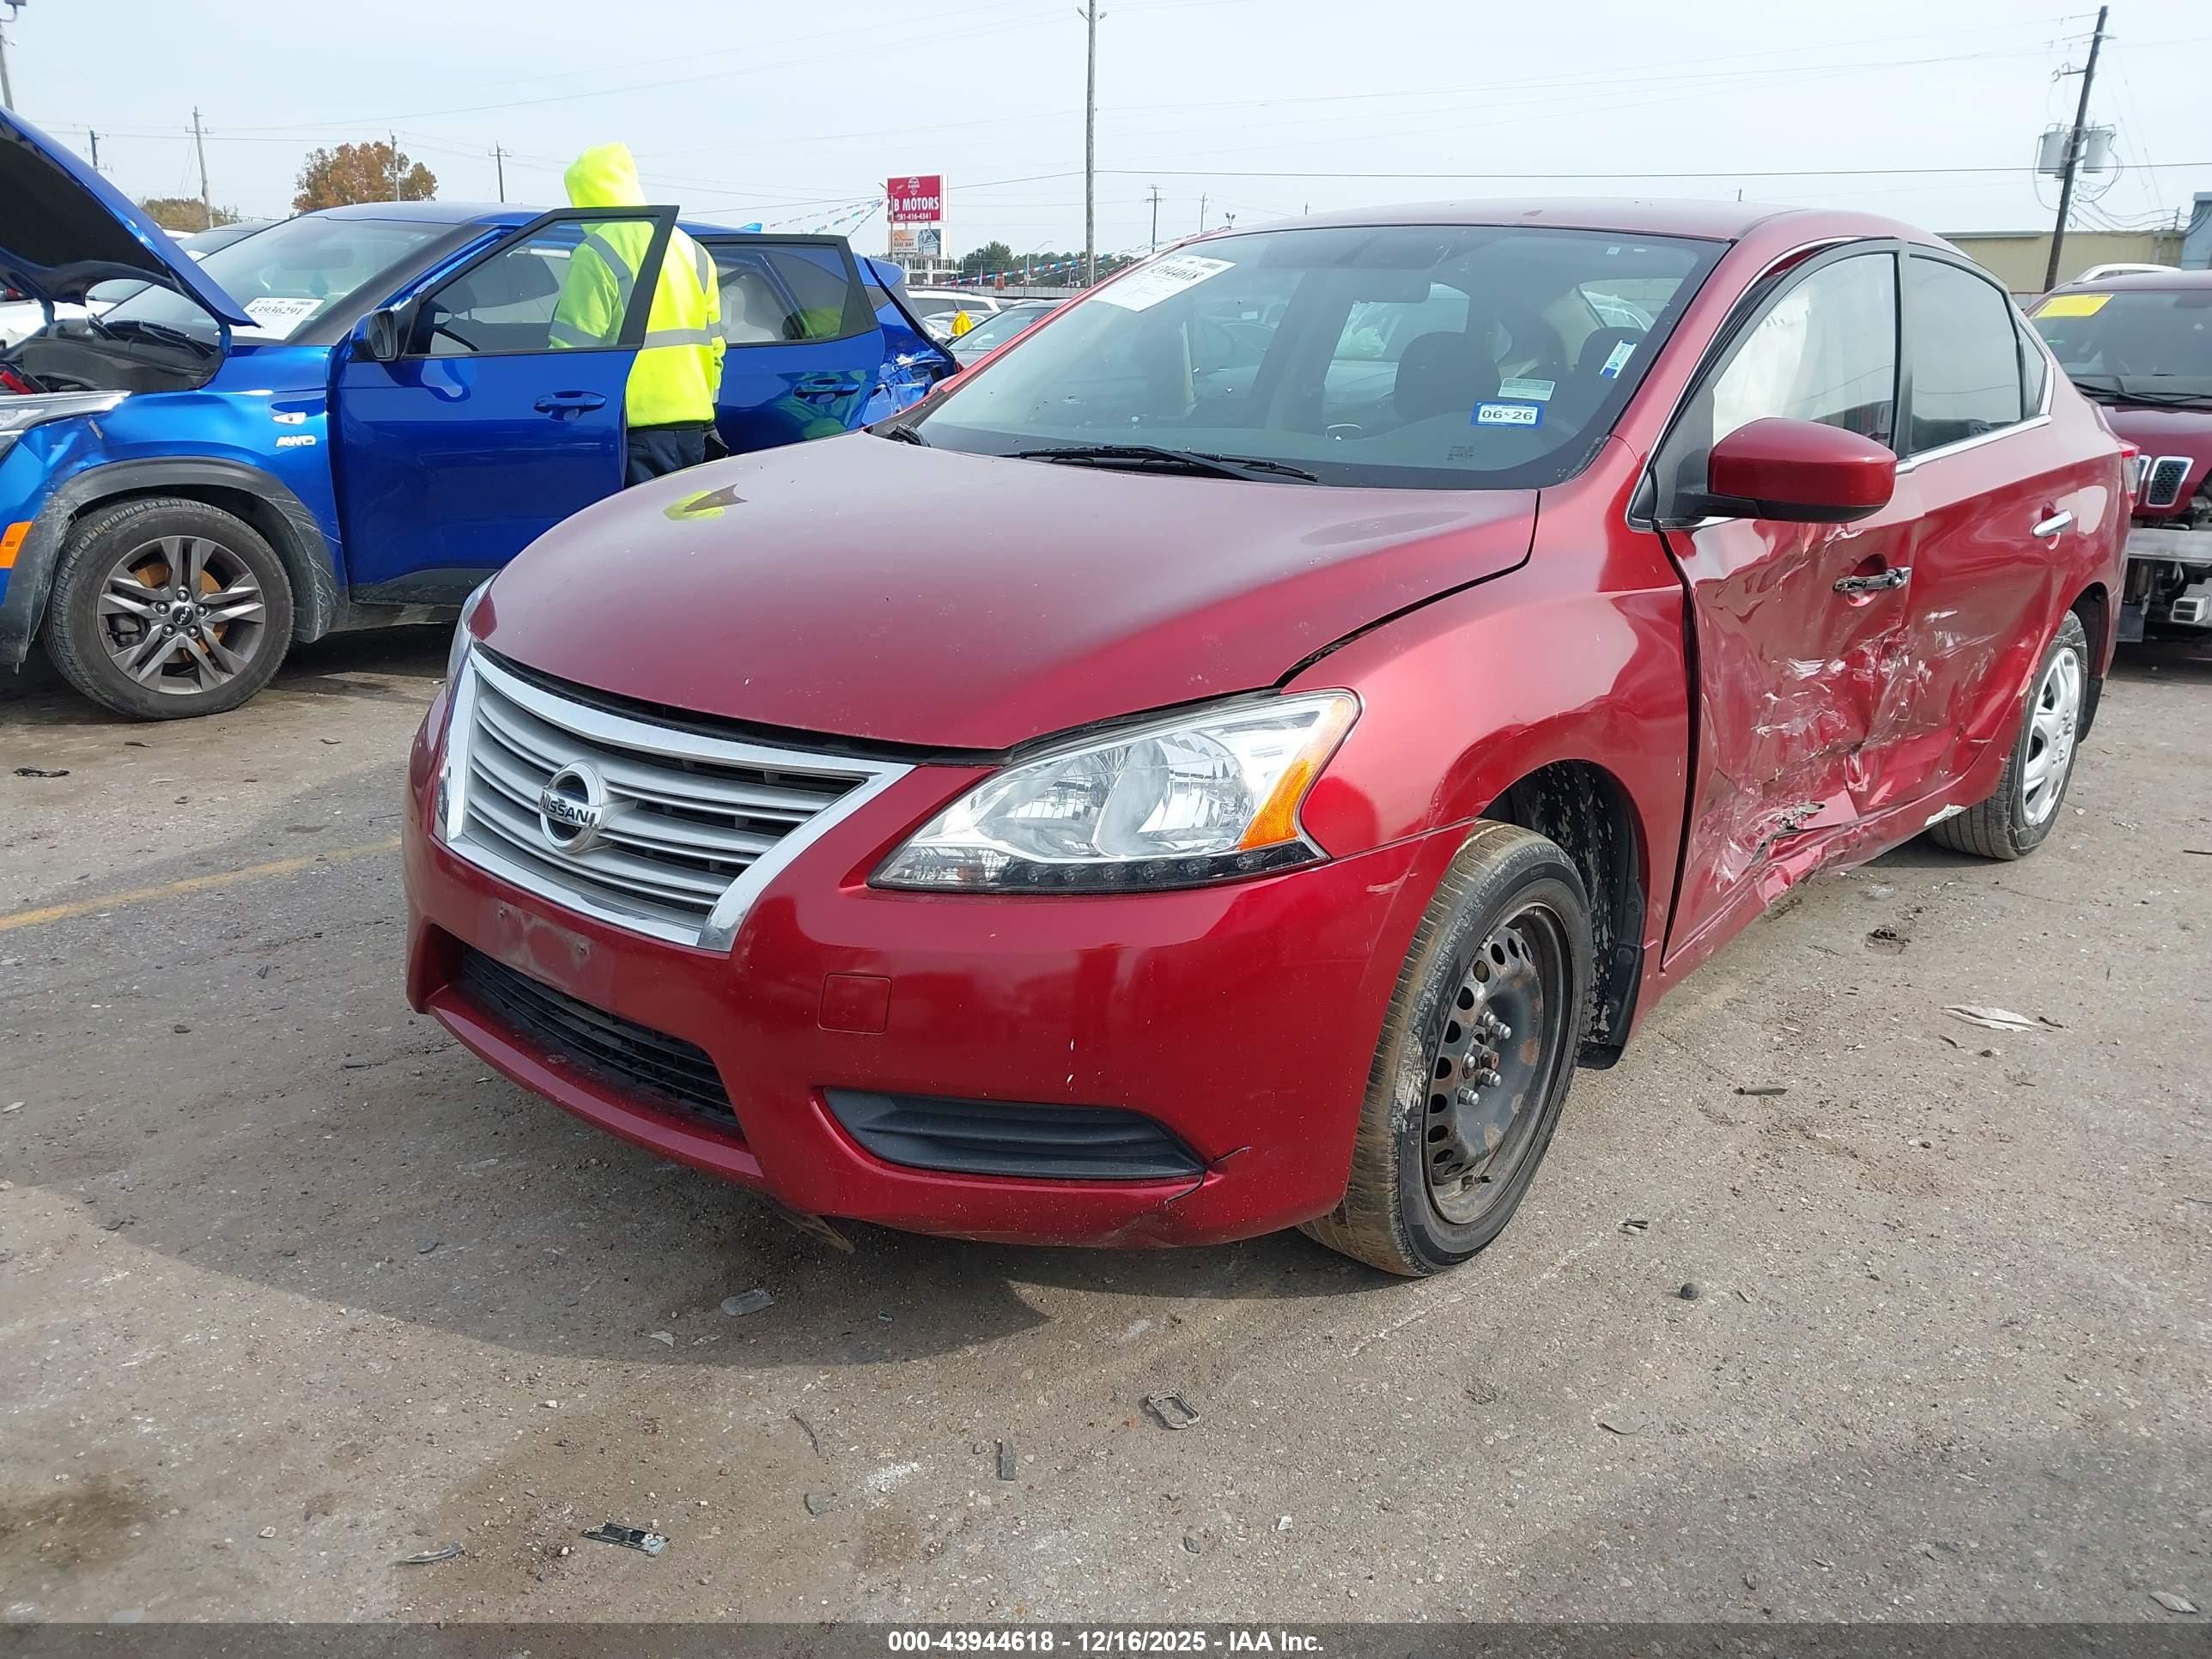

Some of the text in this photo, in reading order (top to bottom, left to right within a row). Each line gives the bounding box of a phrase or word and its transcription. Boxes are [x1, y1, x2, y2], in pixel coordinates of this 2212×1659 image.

[902, 196, 939, 211] MOTORS
[275, 434, 317, 447] AWD
[539, 790, 589, 823] NISSAN
